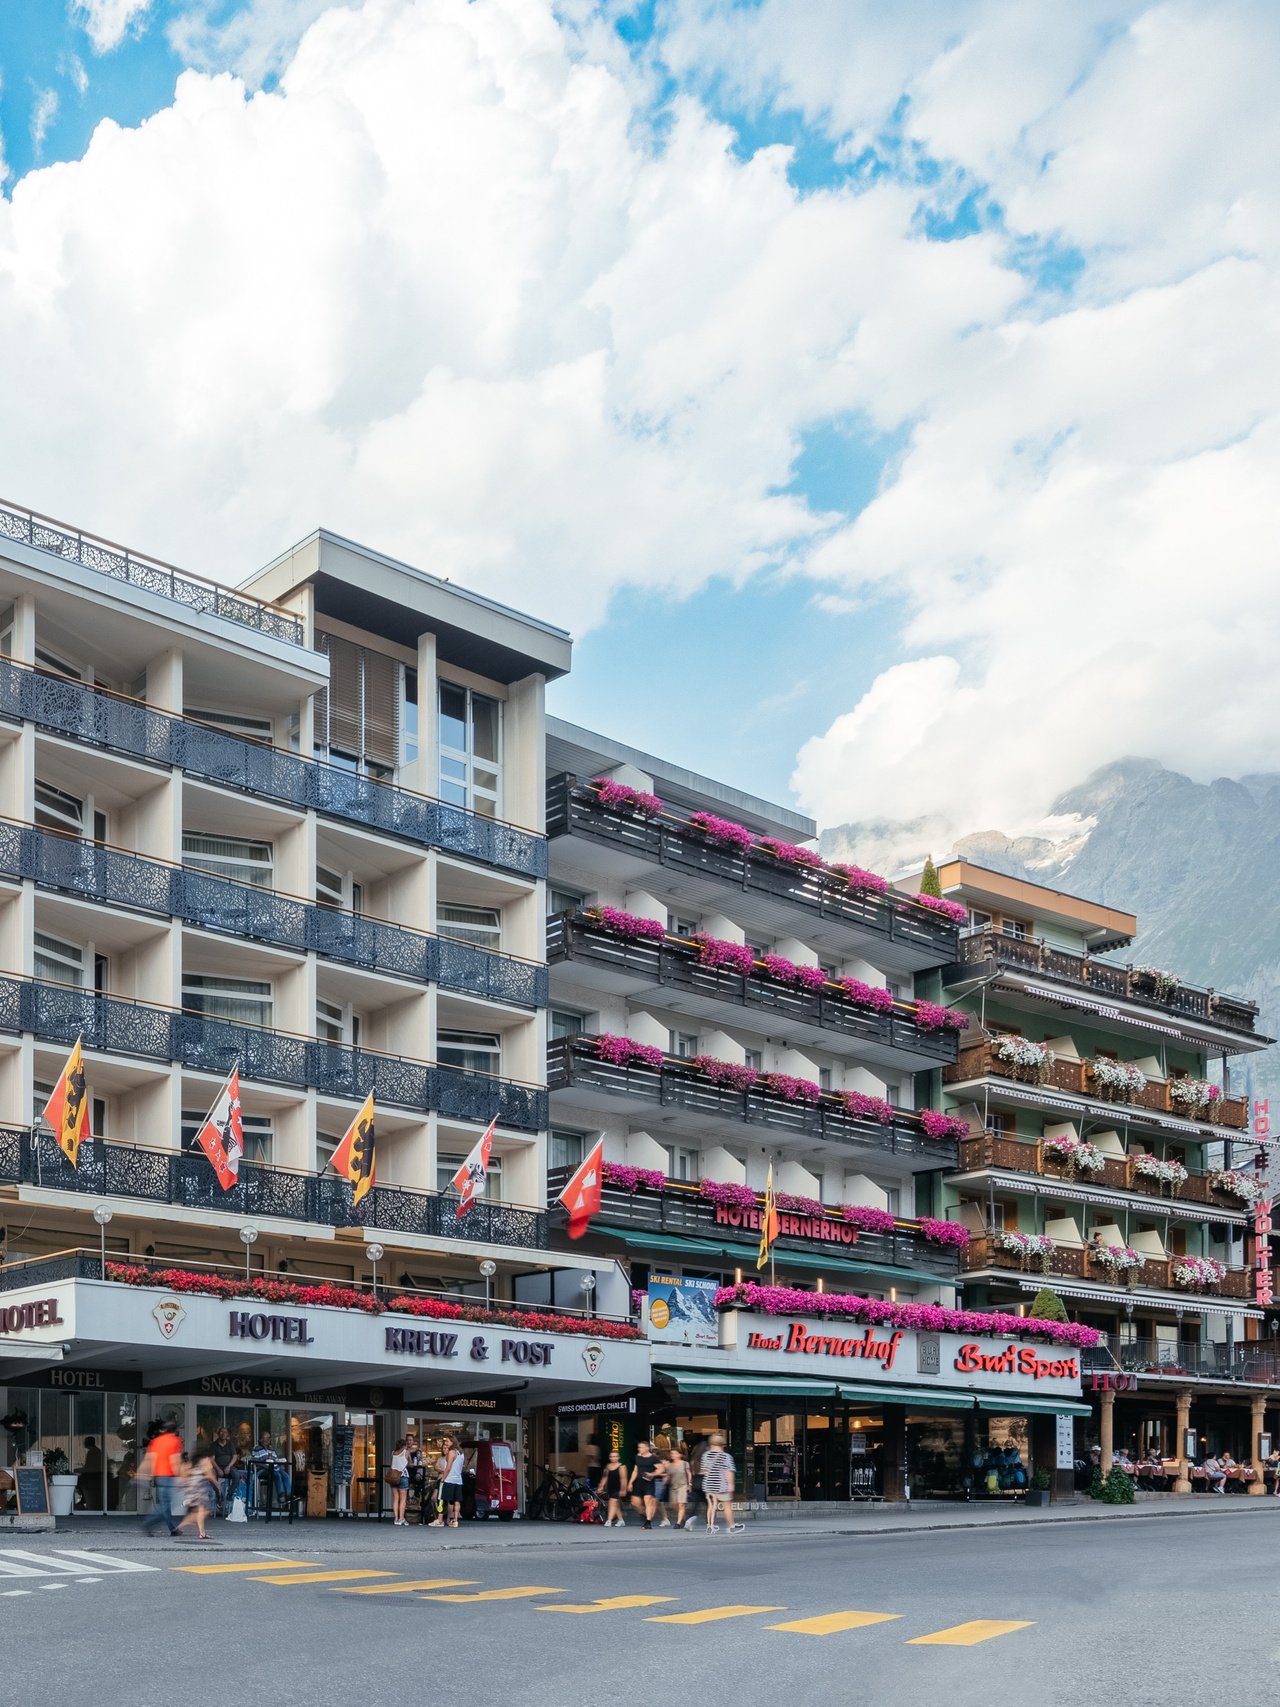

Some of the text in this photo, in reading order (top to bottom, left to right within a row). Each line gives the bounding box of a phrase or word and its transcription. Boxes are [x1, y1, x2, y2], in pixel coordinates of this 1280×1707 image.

[1254, 1098, 1273, 1304] HOTEL WOLTER
[650, 1275, 717, 1290] SKI RENTAL SKI SCHOOL
[228, 1311, 315, 1344] HOTEL
[384, 1326, 555, 1366] KREUZ & POST
[749, 1323, 904, 1370] Hotel Bernerhof
[923, 1345, 939, 1356] BURI
[923, 1357, 939, 1367] HOME
[954, 1343, 1079, 1379] Buri Sport
[50, 1369, 105, 1388] HOTEL
[201, 1376, 252, 1394] SNACK
[263, 1380, 292, 1397] BAR
[304, 1393, 347, 1404] TAKE AWAY
[479, 1400, 496, 1408] CHALET
[575, 1402, 606, 1412] CHOCOLATE
[606, 1401, 628, 1409] CHALET
